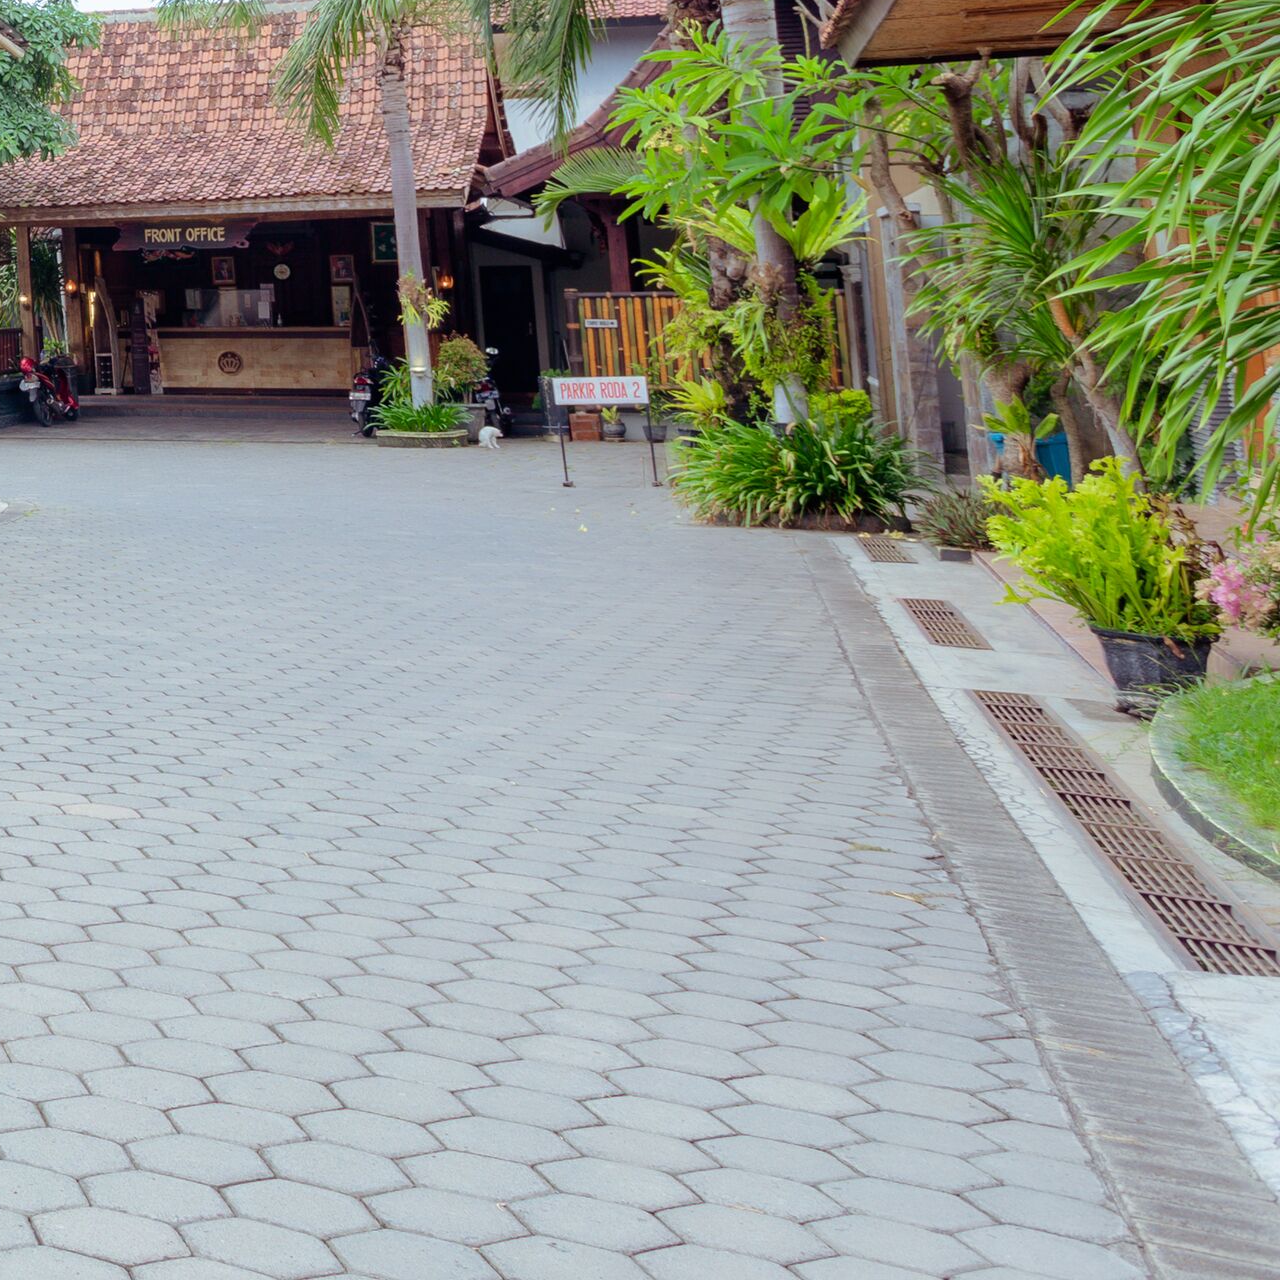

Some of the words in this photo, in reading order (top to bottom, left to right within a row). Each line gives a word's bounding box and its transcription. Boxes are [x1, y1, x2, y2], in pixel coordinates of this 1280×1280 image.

[144, 228, 182, 243] FRONT
[185, 226, 226, 241] OFFICE
[560, 382, 596, 400] PARKIR
[600, 381, 628, 399] RODA
[632, 381, 642, 398] 2
